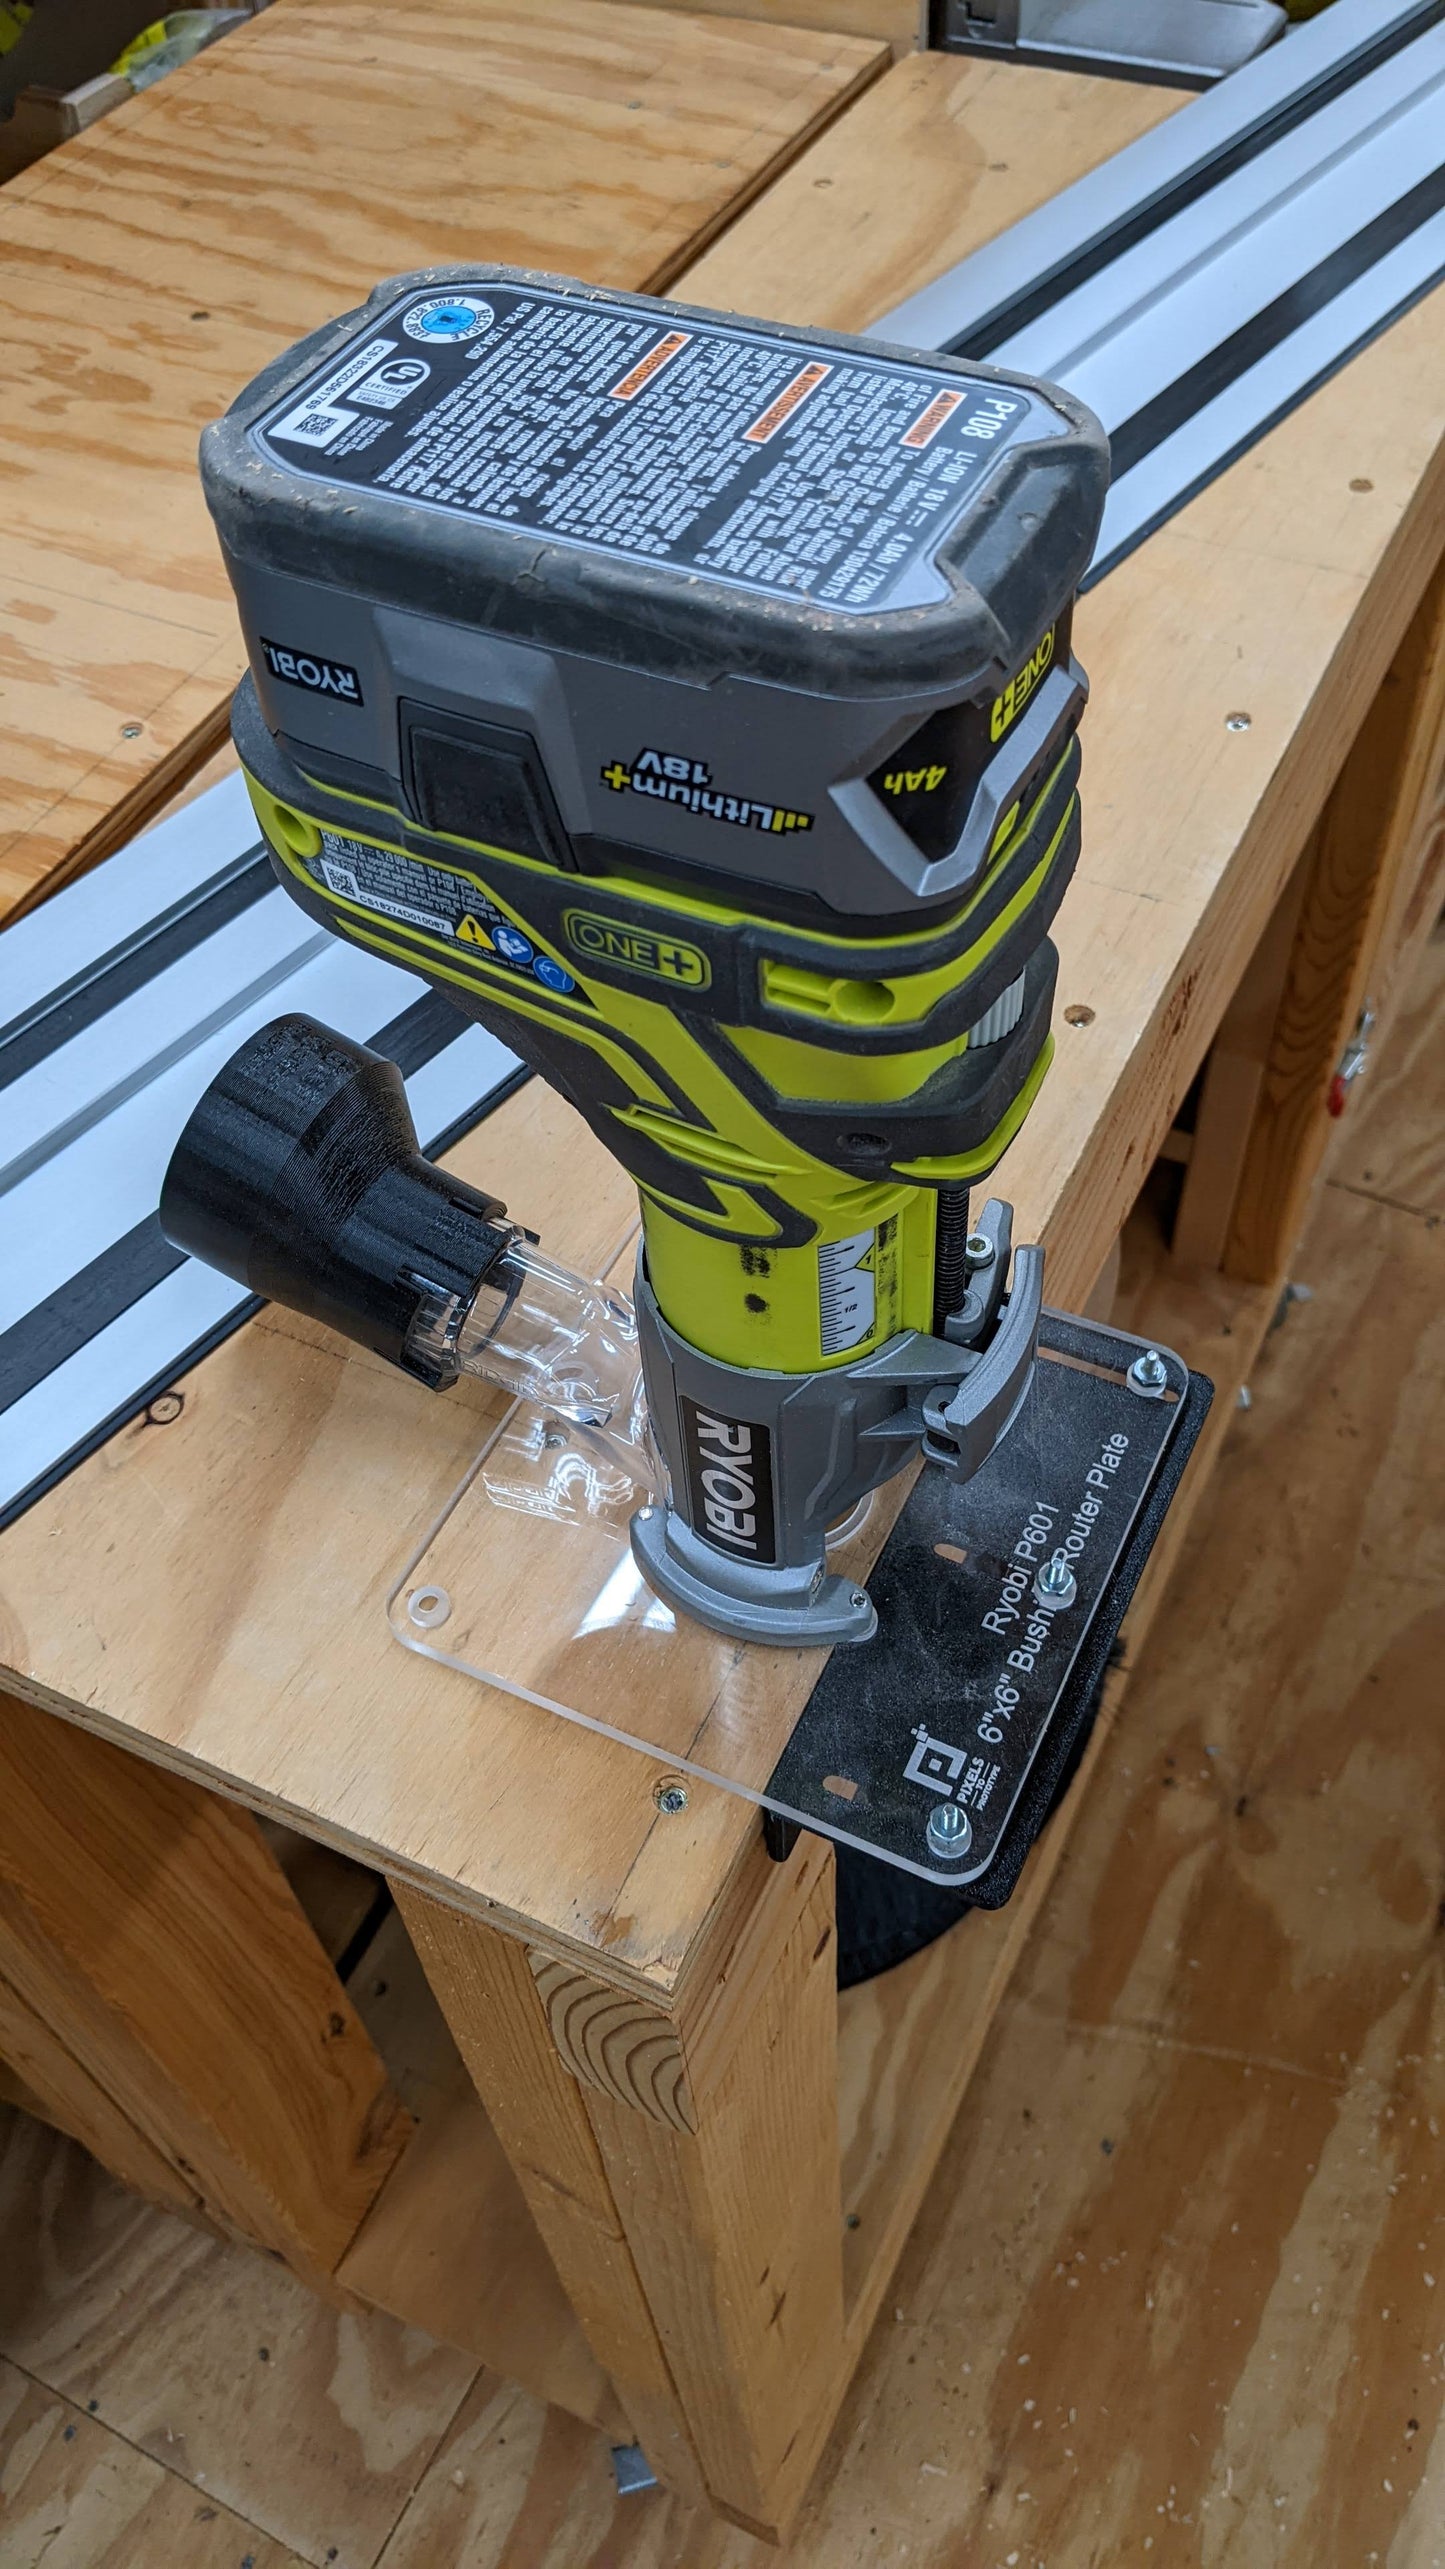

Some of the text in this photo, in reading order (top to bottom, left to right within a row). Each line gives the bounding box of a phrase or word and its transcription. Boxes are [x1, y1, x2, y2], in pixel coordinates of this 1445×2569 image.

[450, 308, 492, 341] RECYCLE
[383, 366, 423, 381] UL
[612, 345, 675, 396] ADVERTENCIA
[820, 367, 854, 394] making
[846, 370, 872, 388] from
[859, 374, 888, 396] listed
[364, 381, 407, 396] CERTIFIED
[831, 390, 855, 406] tool
[903, 393, 928, 409] Fire
[747, 375, 818, 439] AVERTISSEMENT
[811, 407, 838, 428] when
[890, 409, 911, 425] and
[960, 397, 1018, 439] P108
[854, 407, 897, 445] Incinerate
[904, 402, 952, 445] WARNING
[793, 441, 830, 472] Manual
[875, 445, 901, 466] must
[914, 445, 954, 476] Battery
[748, 461, 791, 497] changing
[816, 468, 846, 490] Short
[845, 463, 869, 479] Not
[859, 466, 883, 486] read
[875, 461, 906, 489] reduce
[790, 481, 815, 497] Use
[862, 489, 885, 505] the
[886, 479, 927, 513] Batterie
[917, 487, 948, 511] 18V
[735, 504, 776, 538] Remove
[771, 499, 797, 518] only
[846, 507, 870, 524] risk
[755, 519, 780, 538] with
[782, 532, 812, 553] Heat
[708, 538, 746, 568] battery
[726, 539, 762, 573] charger
[743, 547, 779, 577] Follow
[874, 532, 914, 564] 4.0Ah
[759, 553, 794, 580] Above
[794, 568, 819, 591] user
[818, 550, 870, 598] 130429175
[844, 571, 885, 603] 72Wh
[269, 647, 358, 699] RYOBI
[994, 631, 1053, 727] ONE+
[636, 750, 710, 784] 18V
[884, 764, 947, 795] 4Ah
[604, 763, 773, 830] Lithium+
[578, 924, 693, 976] ONE+
[844, 1303, 858, 1314] 1/2
[694, 1411, 757, 1550] RYOBI
[1006, 1596, 1057, 1673] Bush
[1050, 1490, 1103, 1570] Router
[1085, 1432, 1130, 1489] Plate
[981, 1500, 1060, 1636] Ryobi P601
[956, 1756, 985, 1804] PIXELS
[975, 1778, 986, 1791] TO
[976, 1764, 1001, 1811] PROTOTYPE
